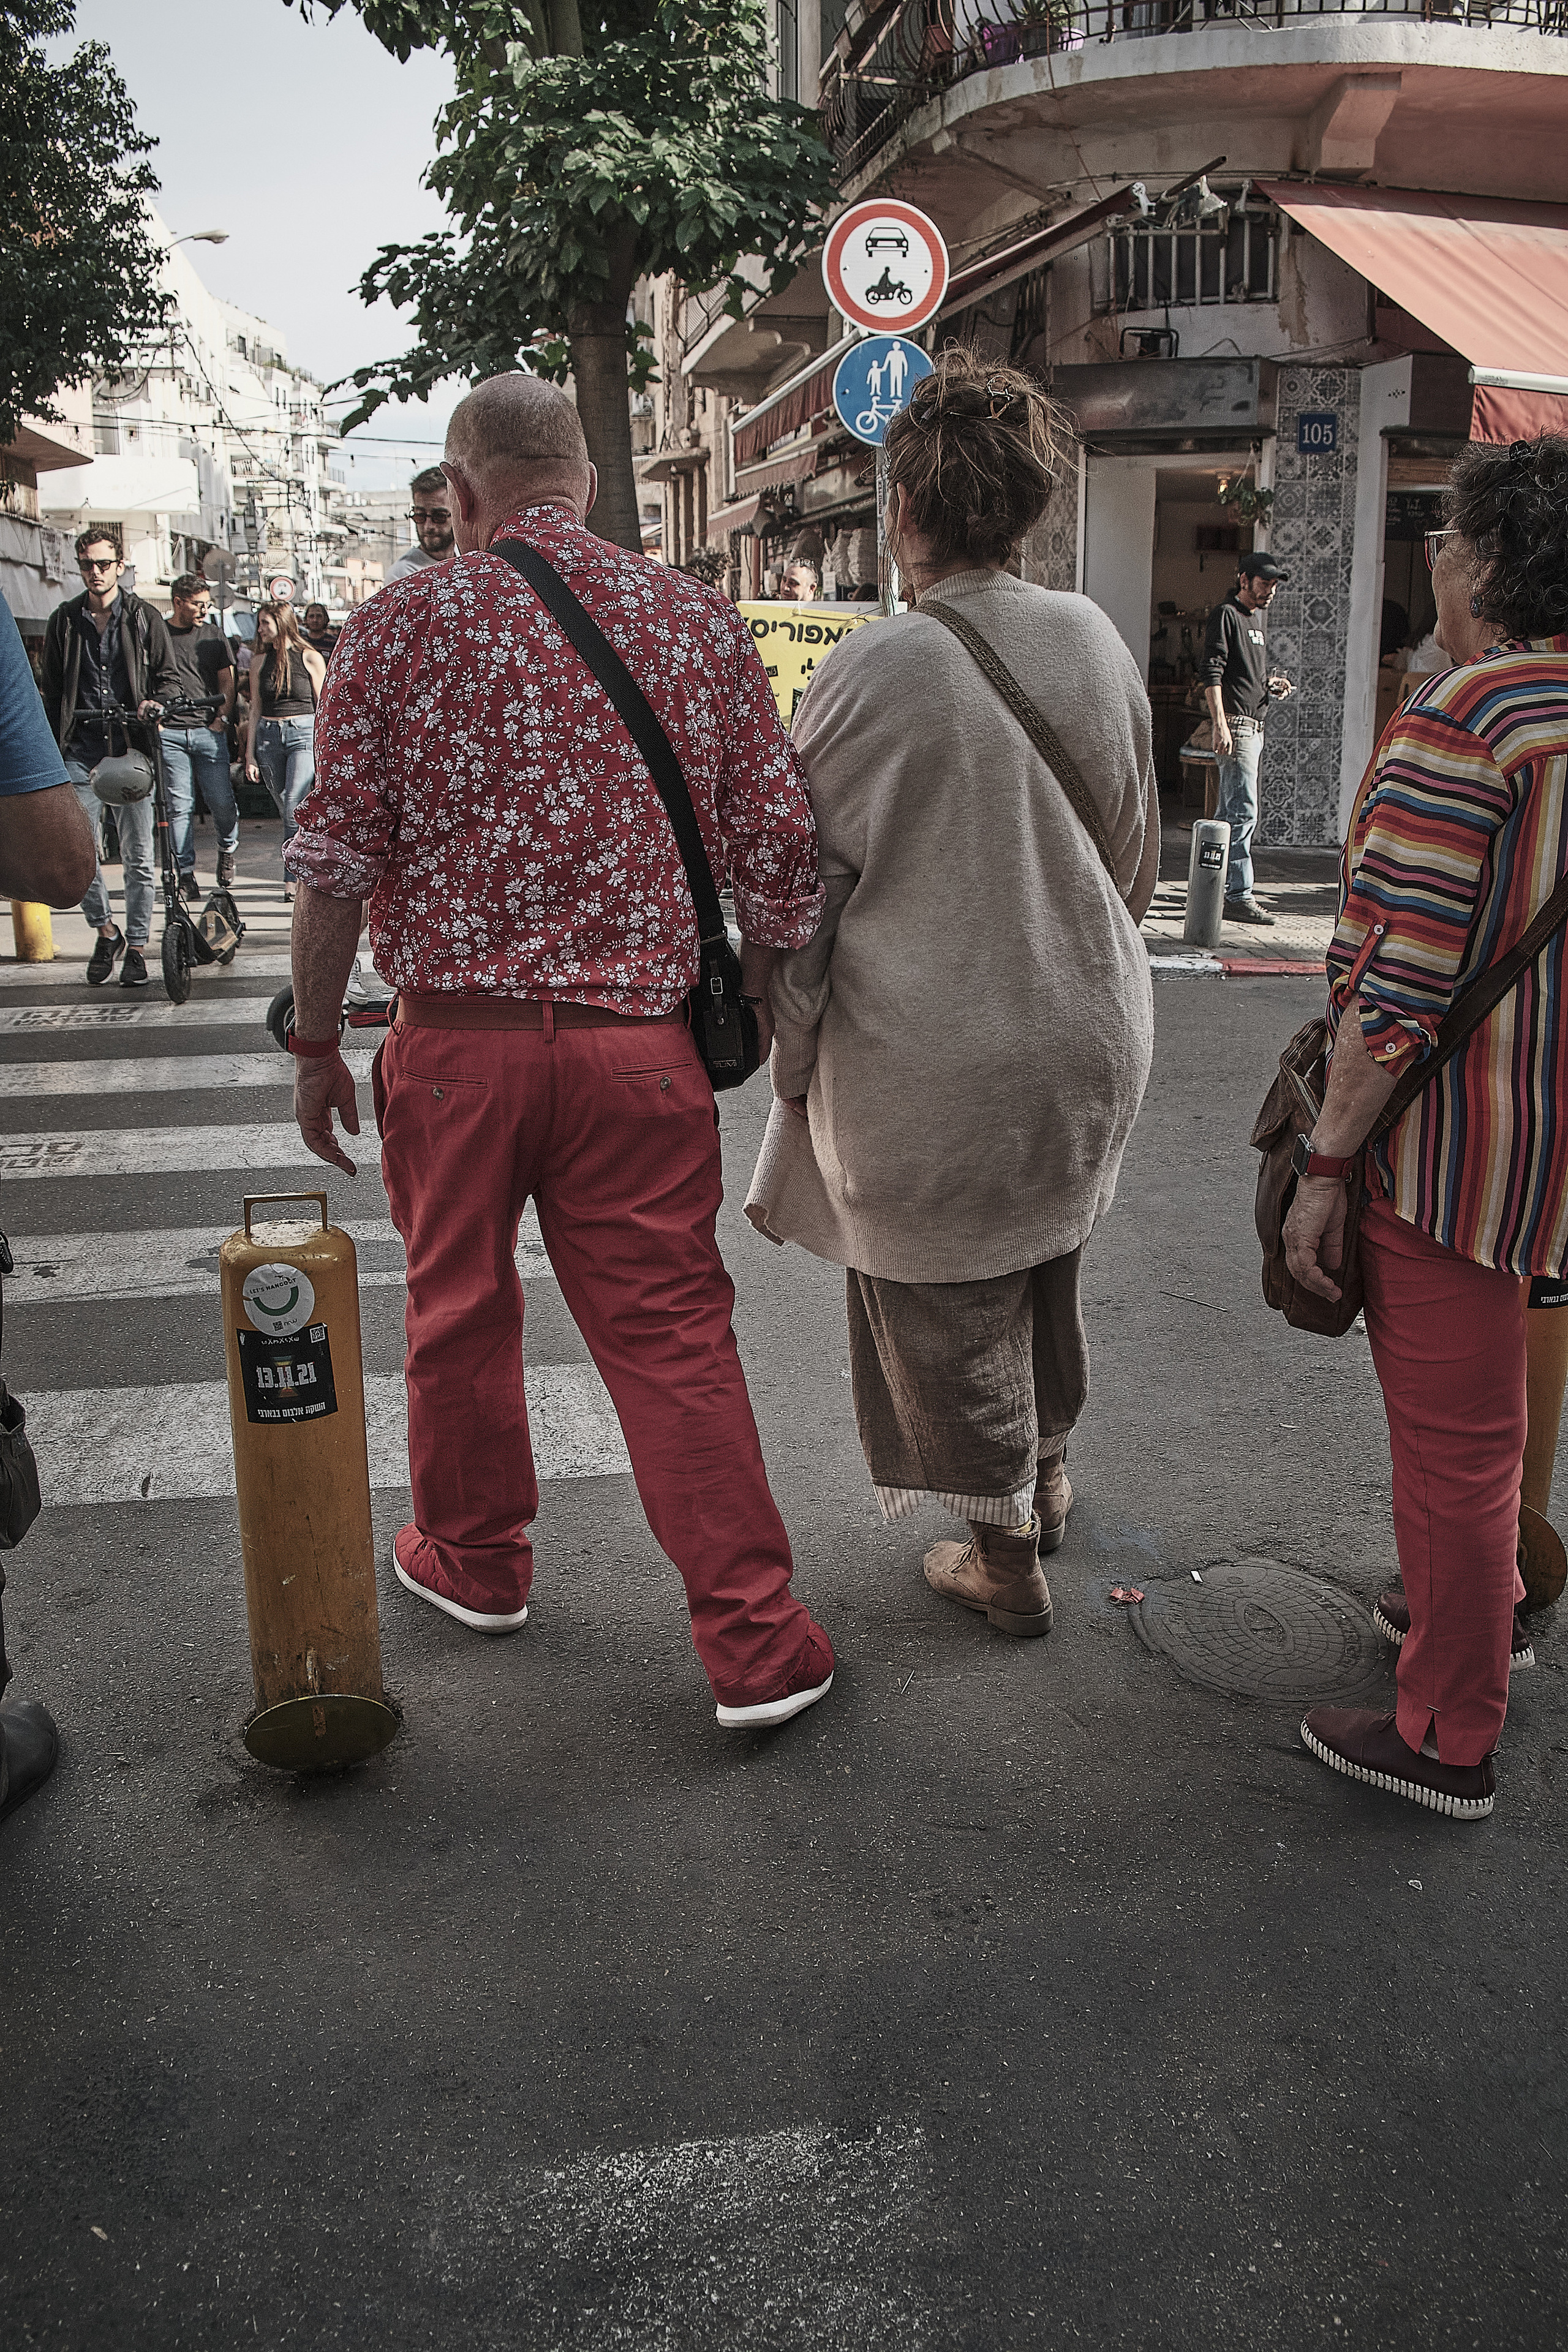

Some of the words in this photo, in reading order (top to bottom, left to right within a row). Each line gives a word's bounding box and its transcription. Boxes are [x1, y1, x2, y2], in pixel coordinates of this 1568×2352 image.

[1303, 423, 1333, 445] 105
[256, 1362, 317, 1388] 13.11.21
[282, 1407, 304, 1417] אלבום
[305, 1401, 326, 1414] השקת
